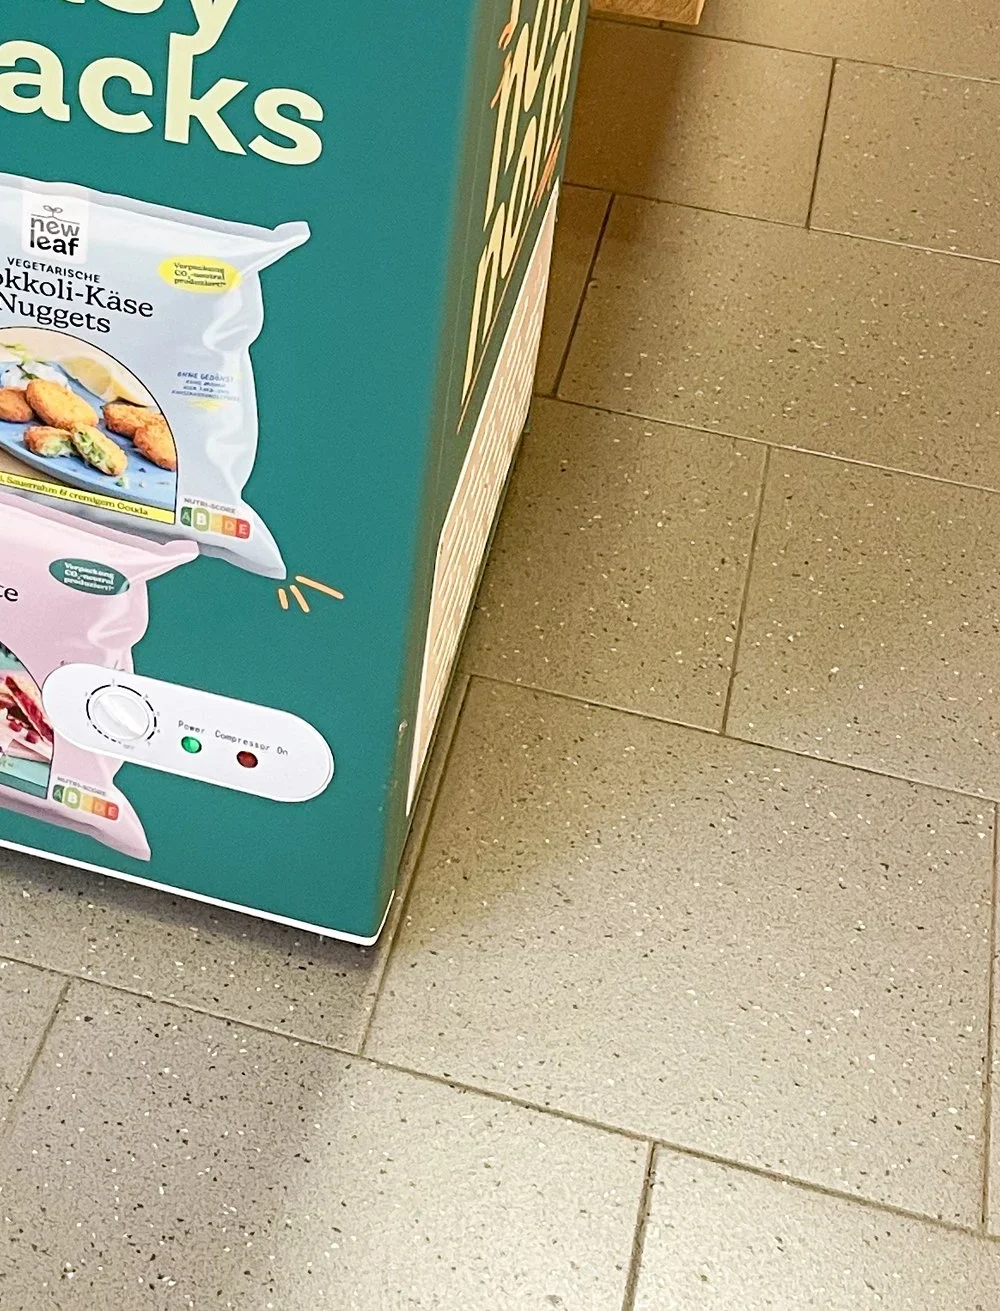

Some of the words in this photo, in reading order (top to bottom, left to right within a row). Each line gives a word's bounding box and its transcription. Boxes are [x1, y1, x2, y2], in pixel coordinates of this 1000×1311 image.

[30, 217, 80, 237] new
[29, 231, 80, 256] leaf
[7, 256, 101, 283] VEGETARISCHE
[117, 501, 148, 516] Gouda
[178, 720, 205, 734] Power
[215, 730, 270, 751] Compressor
[277, 746, 288, 756] On
